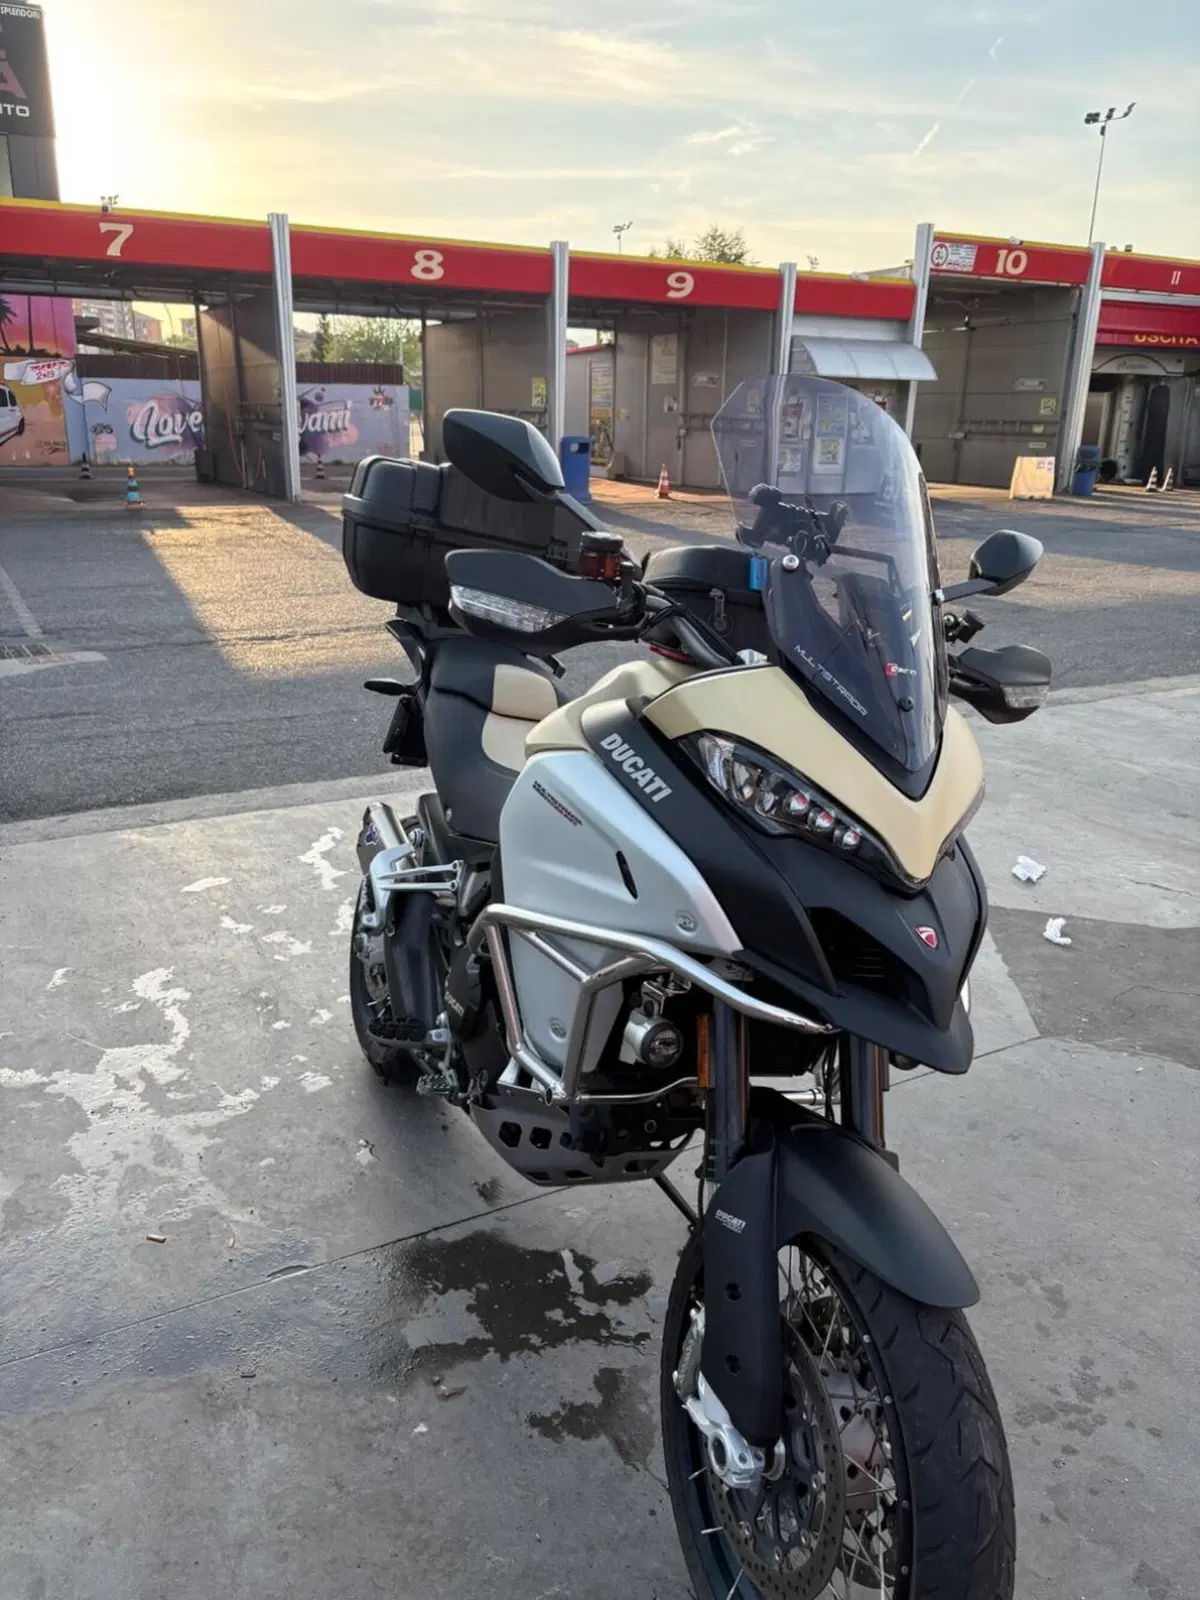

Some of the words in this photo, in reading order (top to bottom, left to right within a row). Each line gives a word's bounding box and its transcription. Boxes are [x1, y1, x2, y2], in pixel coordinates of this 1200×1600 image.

[99, 222, 134, 257] 7
[410, 249, 445, 281] 8
[995, 248, 1028, 276] 10
[666, 271, 695, 299] 9
[600, 732, 673, 803] DUCATI
[715, 1209, 747, 1230] DUCATI
